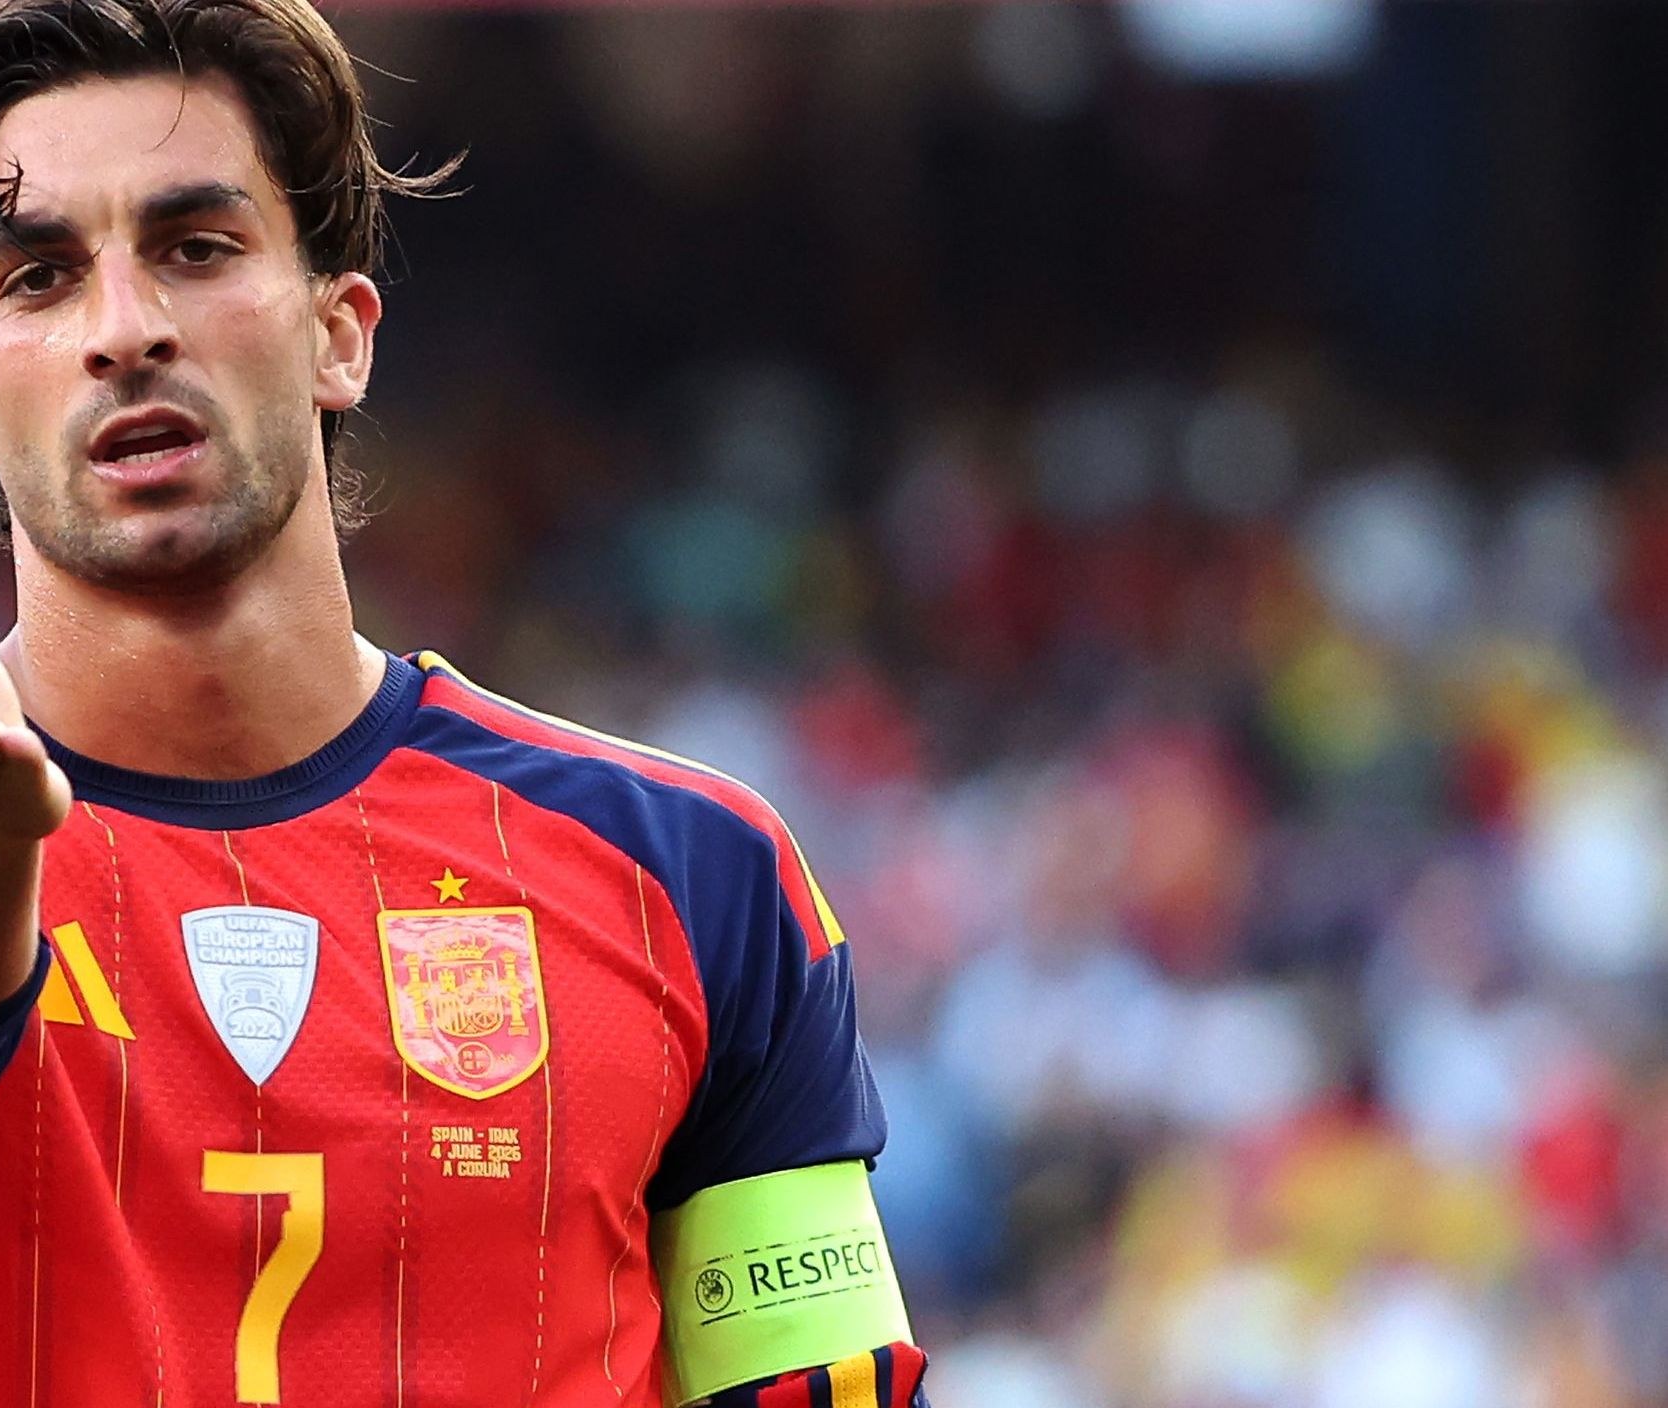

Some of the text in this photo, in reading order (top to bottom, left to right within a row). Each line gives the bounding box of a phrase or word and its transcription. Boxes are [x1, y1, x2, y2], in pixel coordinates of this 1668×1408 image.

[199, 932, 303, 949] EUROPEAN
[201, 949, 304, 966] CHAMPIONS
[231, 1020, 281, 1037] 2024
[431, 1126, 474, 1143] SPAIN
[488, 1127, 519, 1145] IRAK
[430, 1143, 521, 1162] 4 JUNE 2026
[442, 1160, 453, 1177] A
[202, 1151, 324, 1404] 7
[748, 1241, 881, 1296] RESPECT
